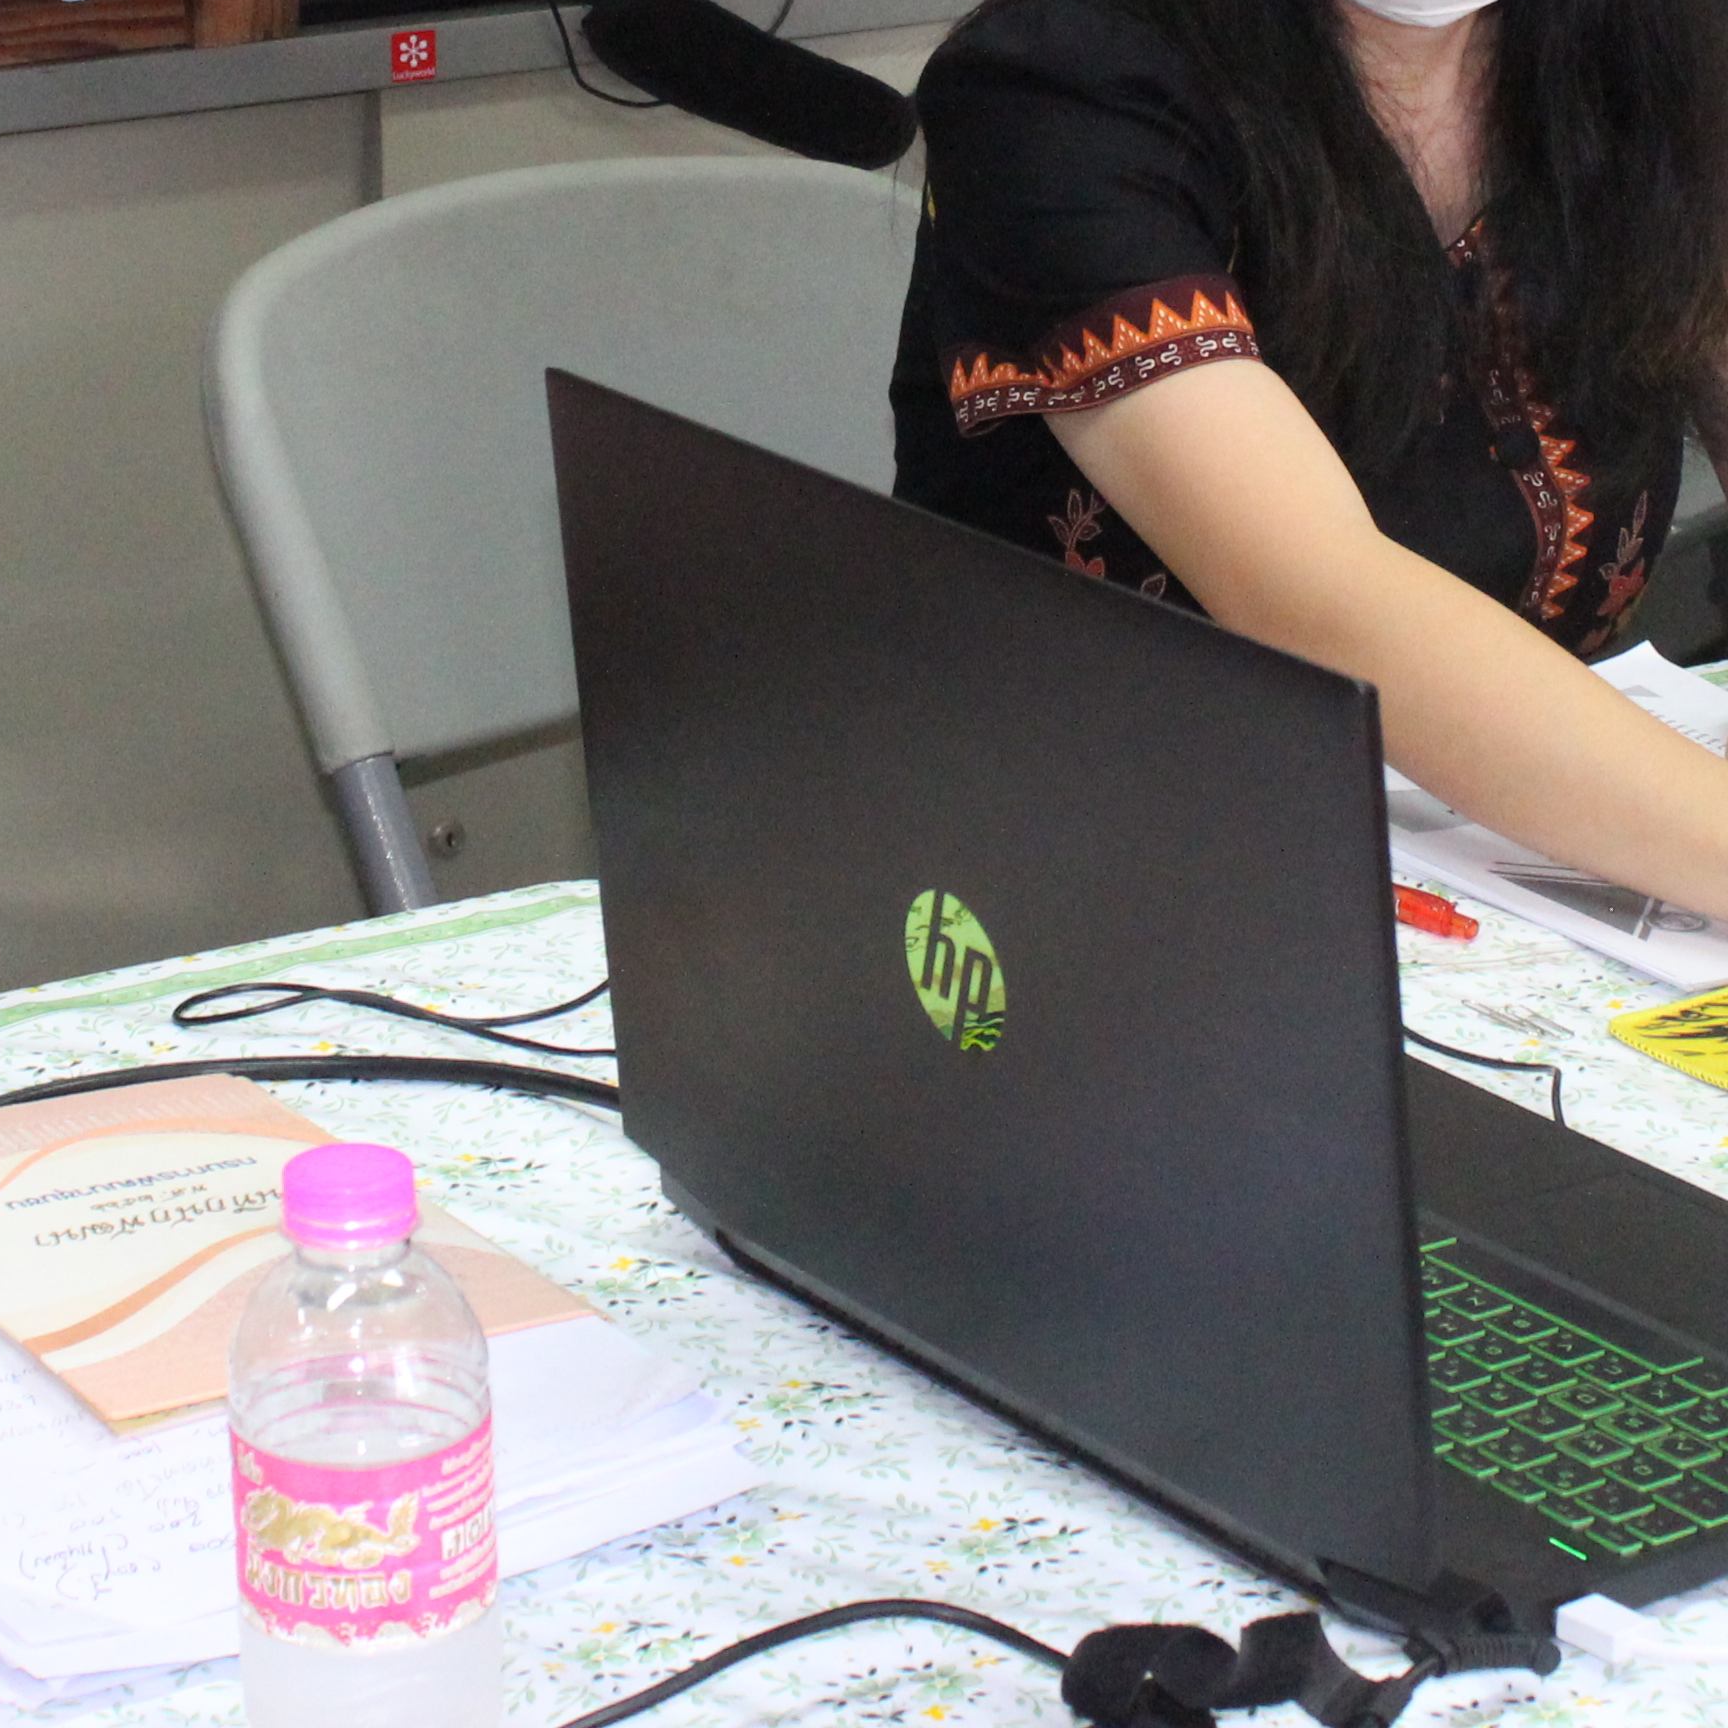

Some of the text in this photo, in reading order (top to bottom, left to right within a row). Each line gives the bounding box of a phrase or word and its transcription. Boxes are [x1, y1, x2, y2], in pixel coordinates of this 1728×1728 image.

[912, 889, 1000, 1050] hp
[3, 1156, 259, 1212] กรมการพัฒนาชุมชน
